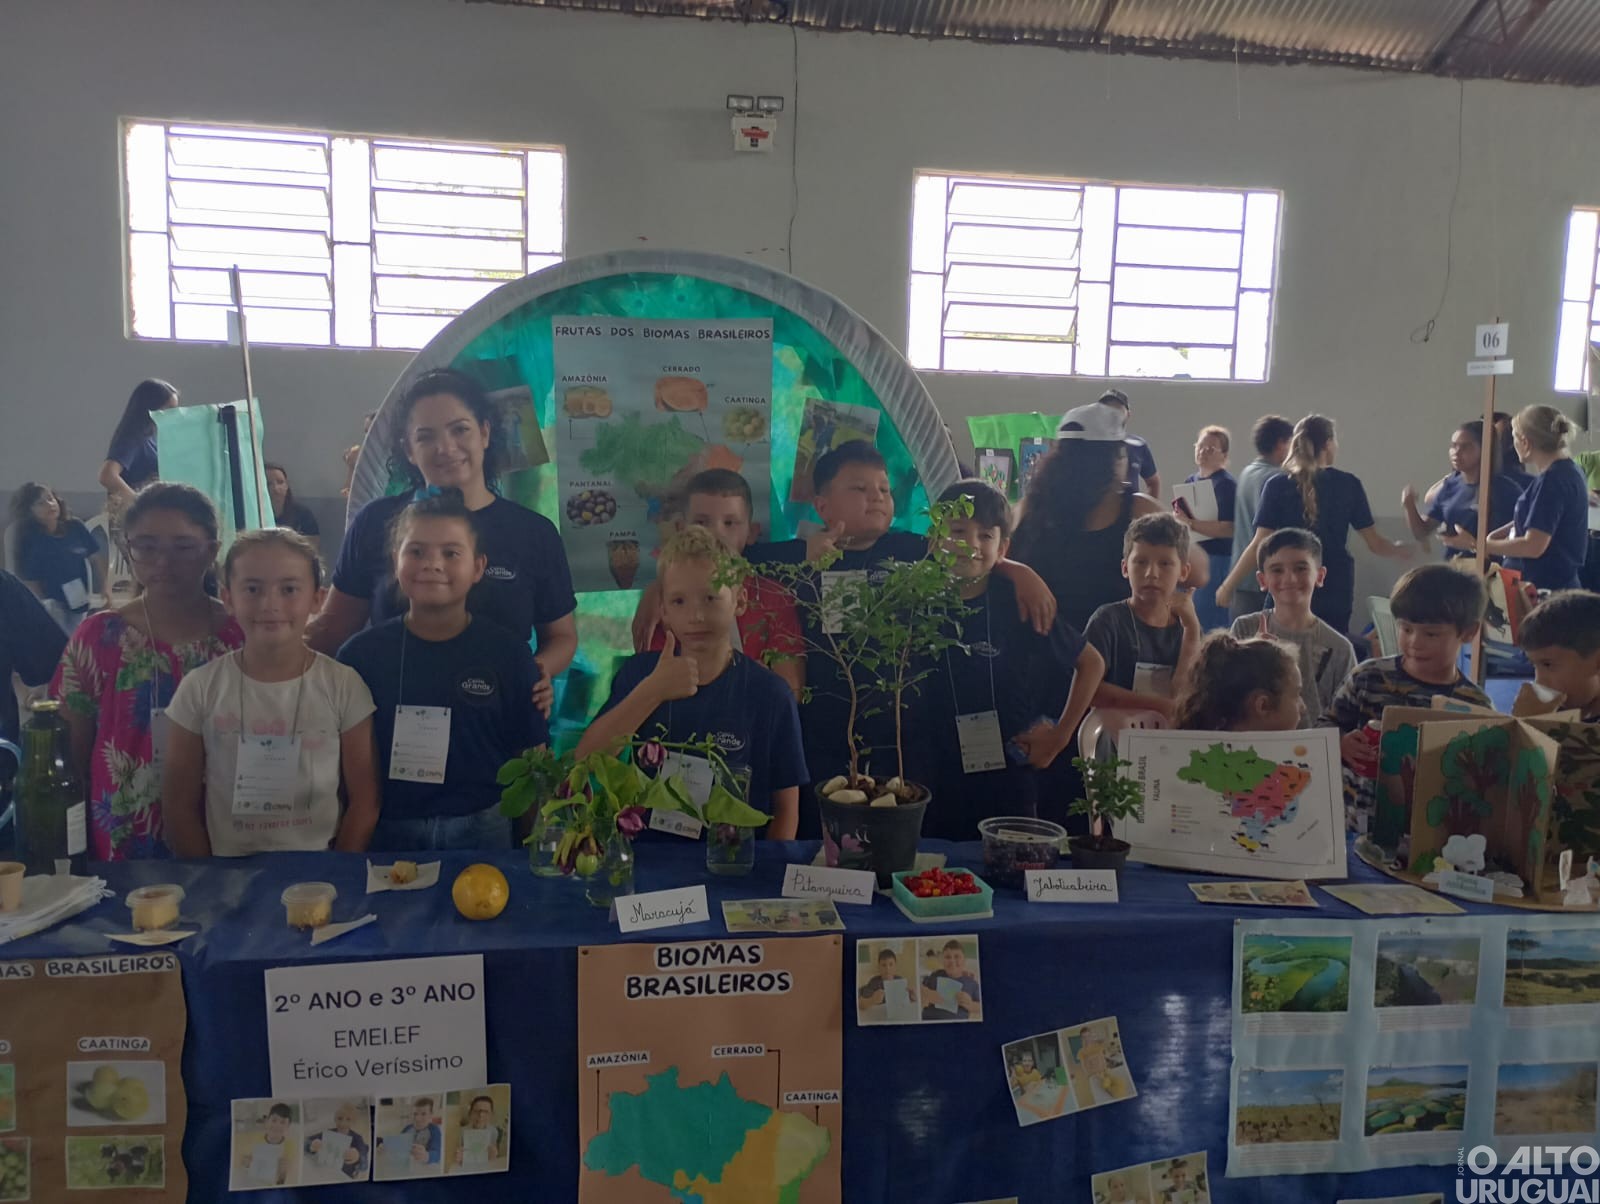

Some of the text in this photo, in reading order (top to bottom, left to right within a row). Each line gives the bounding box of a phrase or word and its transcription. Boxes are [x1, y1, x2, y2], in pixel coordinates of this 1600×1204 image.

[555, 326, 771, 340] FRUTAS DOS BIOMAS BRASILEIROS
[1482, 332, 1500, 348] 06
[662, 365, 701, 373] CERRADO
[724, 396, 767, 404] CAATINGA
[569, 480, 612, 488] PANTANAL
[630, 900, 697, 924] Maracujá
[656, 944, 762, 968] BIOMAS
[0, 955, 175, 977] AS BRASILEIROS
[626, 971, 791, 998] BRASILEIROS
[274, 982, 476, 1013] 2º ANO e 3º ANO
[79, 1038, 149, 1050] CAATINGA
[334, 1025, 421, 1048] EMEI.EF
[713, 1045, 764, 1056] CERRADO
[293, 1053, 464, 1080] Érico Veríssimo
[785, 1091, 839, 1102] CAATINGA
